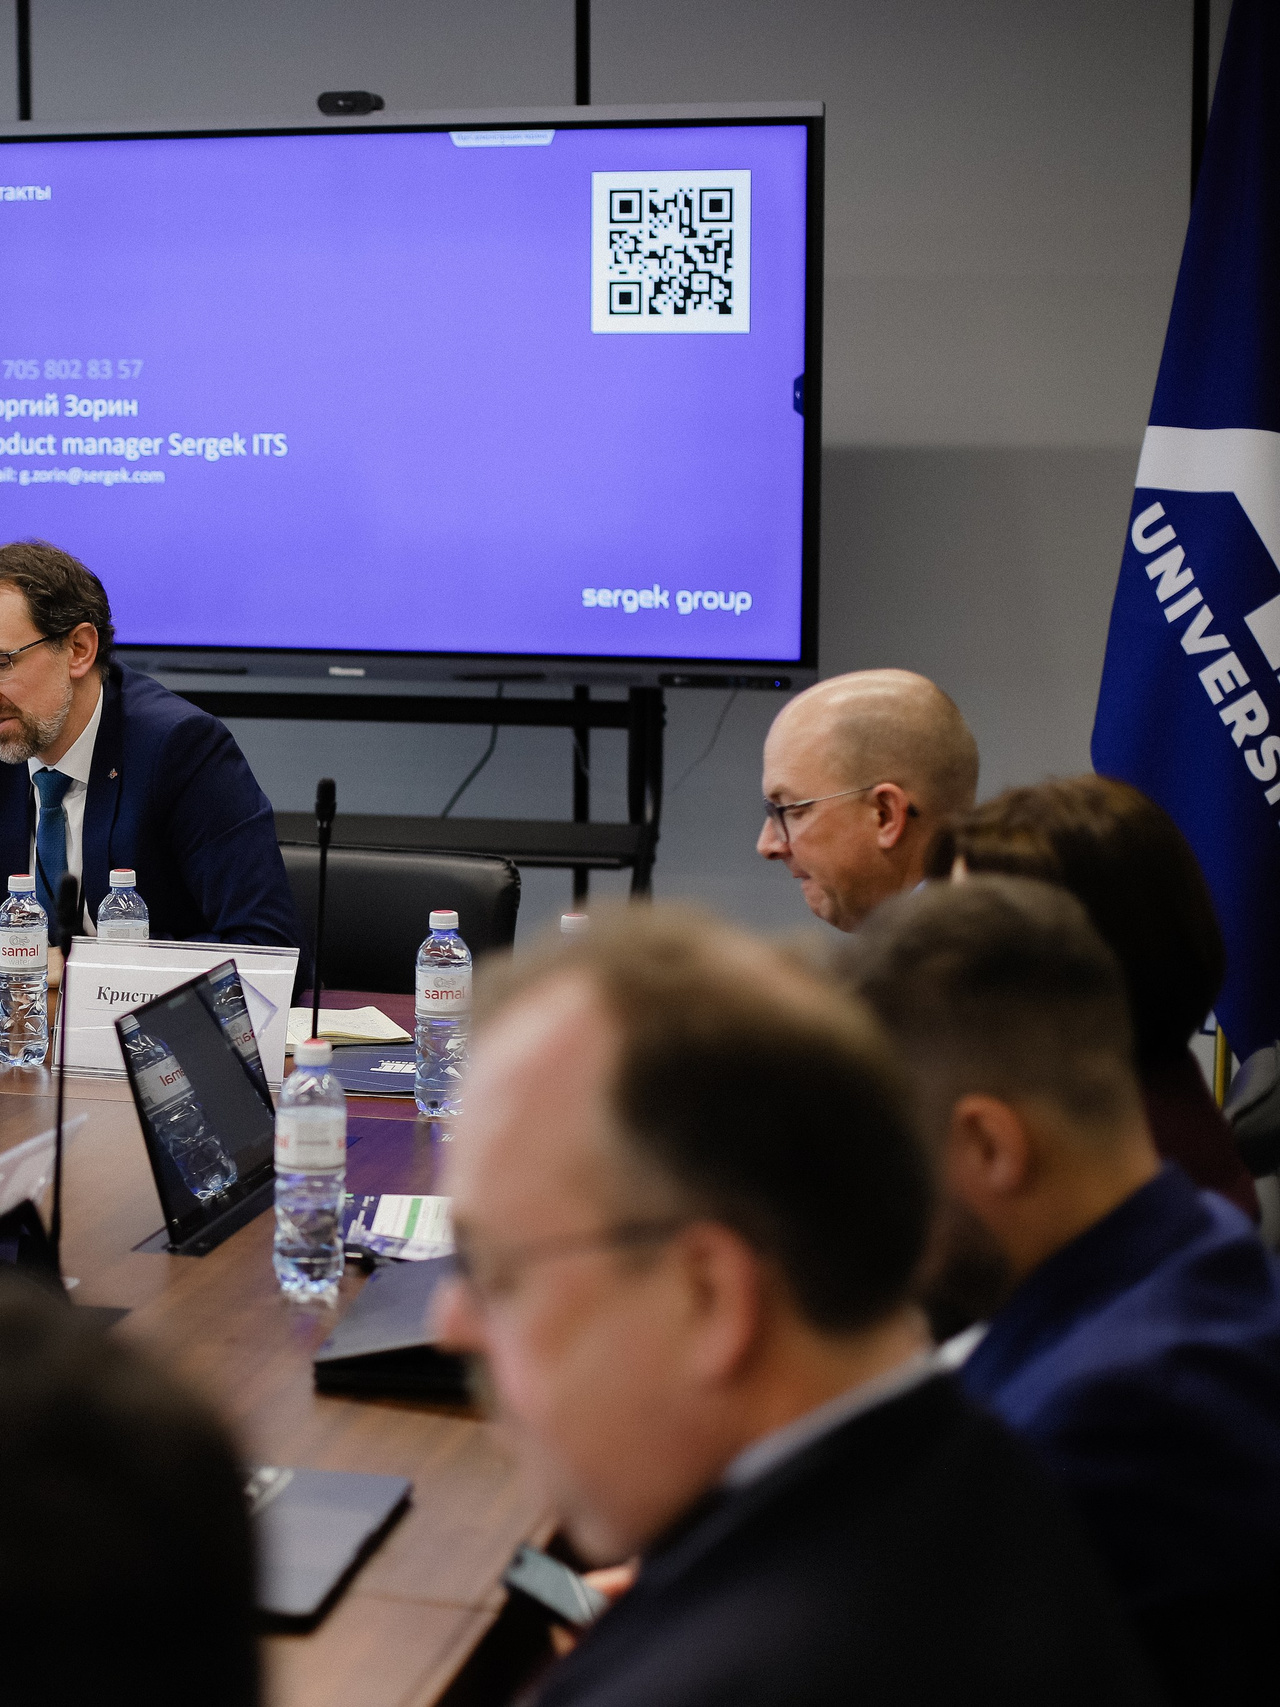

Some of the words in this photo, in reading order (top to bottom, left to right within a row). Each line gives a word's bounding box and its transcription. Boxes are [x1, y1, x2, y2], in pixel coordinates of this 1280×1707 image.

[3, 359, 39, 380] 705
[44, 359, 82, 380] 802
[87, 359, 113, 380] 83
[117, 359, 143, 379] 57
[64, 394, 138, 422] Зорин
[62, 434, 163, 461] manager
[168, 431, 247, 462] Sergek
[253, 433, 288, 457] ITS
[19, 466, 165, 486] g.zorin@sergek.com
[582, 584, 669, 614] sergek
[675, 590, 753, 616] group
[1, 944, 39, 957] samal
[9, 958, 31, 966] water
[97, 986, 160, 1004] Кристи
[424, 986, 465, 1000] samal
